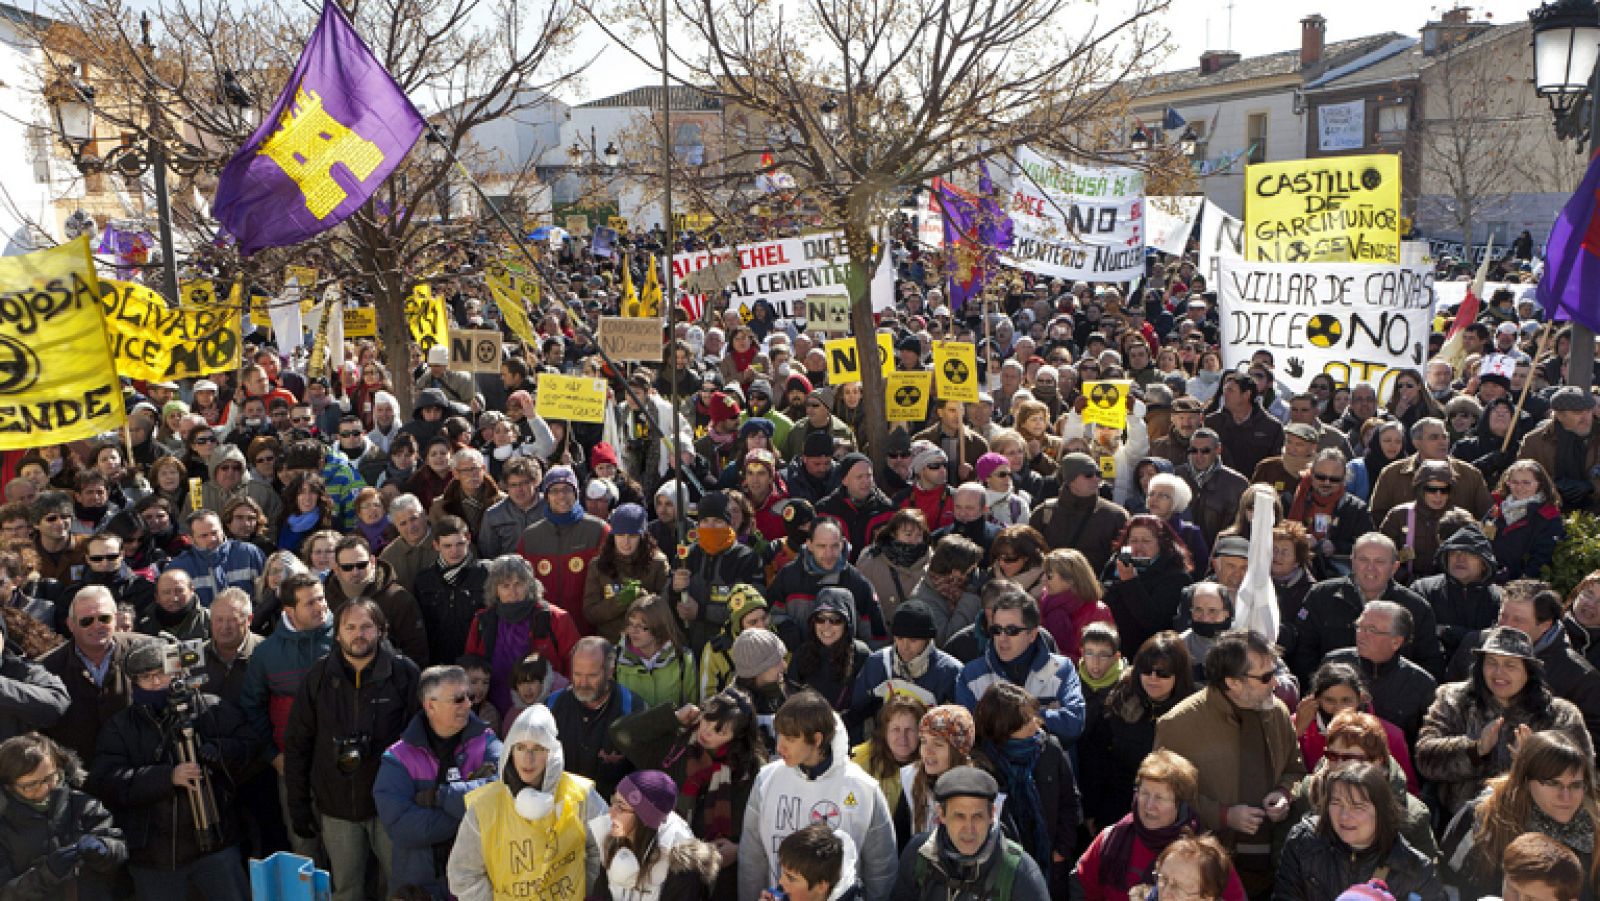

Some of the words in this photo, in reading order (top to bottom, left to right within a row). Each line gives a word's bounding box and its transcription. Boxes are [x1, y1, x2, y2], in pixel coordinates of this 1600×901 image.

[1069, 203, 1118, 234] NO
[1305, 195, 1350, 213] DE
[1231, 270, 1318, 306] VILLAR
[1320, 274, 1355, 306] DE
[1229, 309, 1309, 350] DICE
[1345, 310, 1410, 356] NO
[111, 333, 161, 367] ICE
